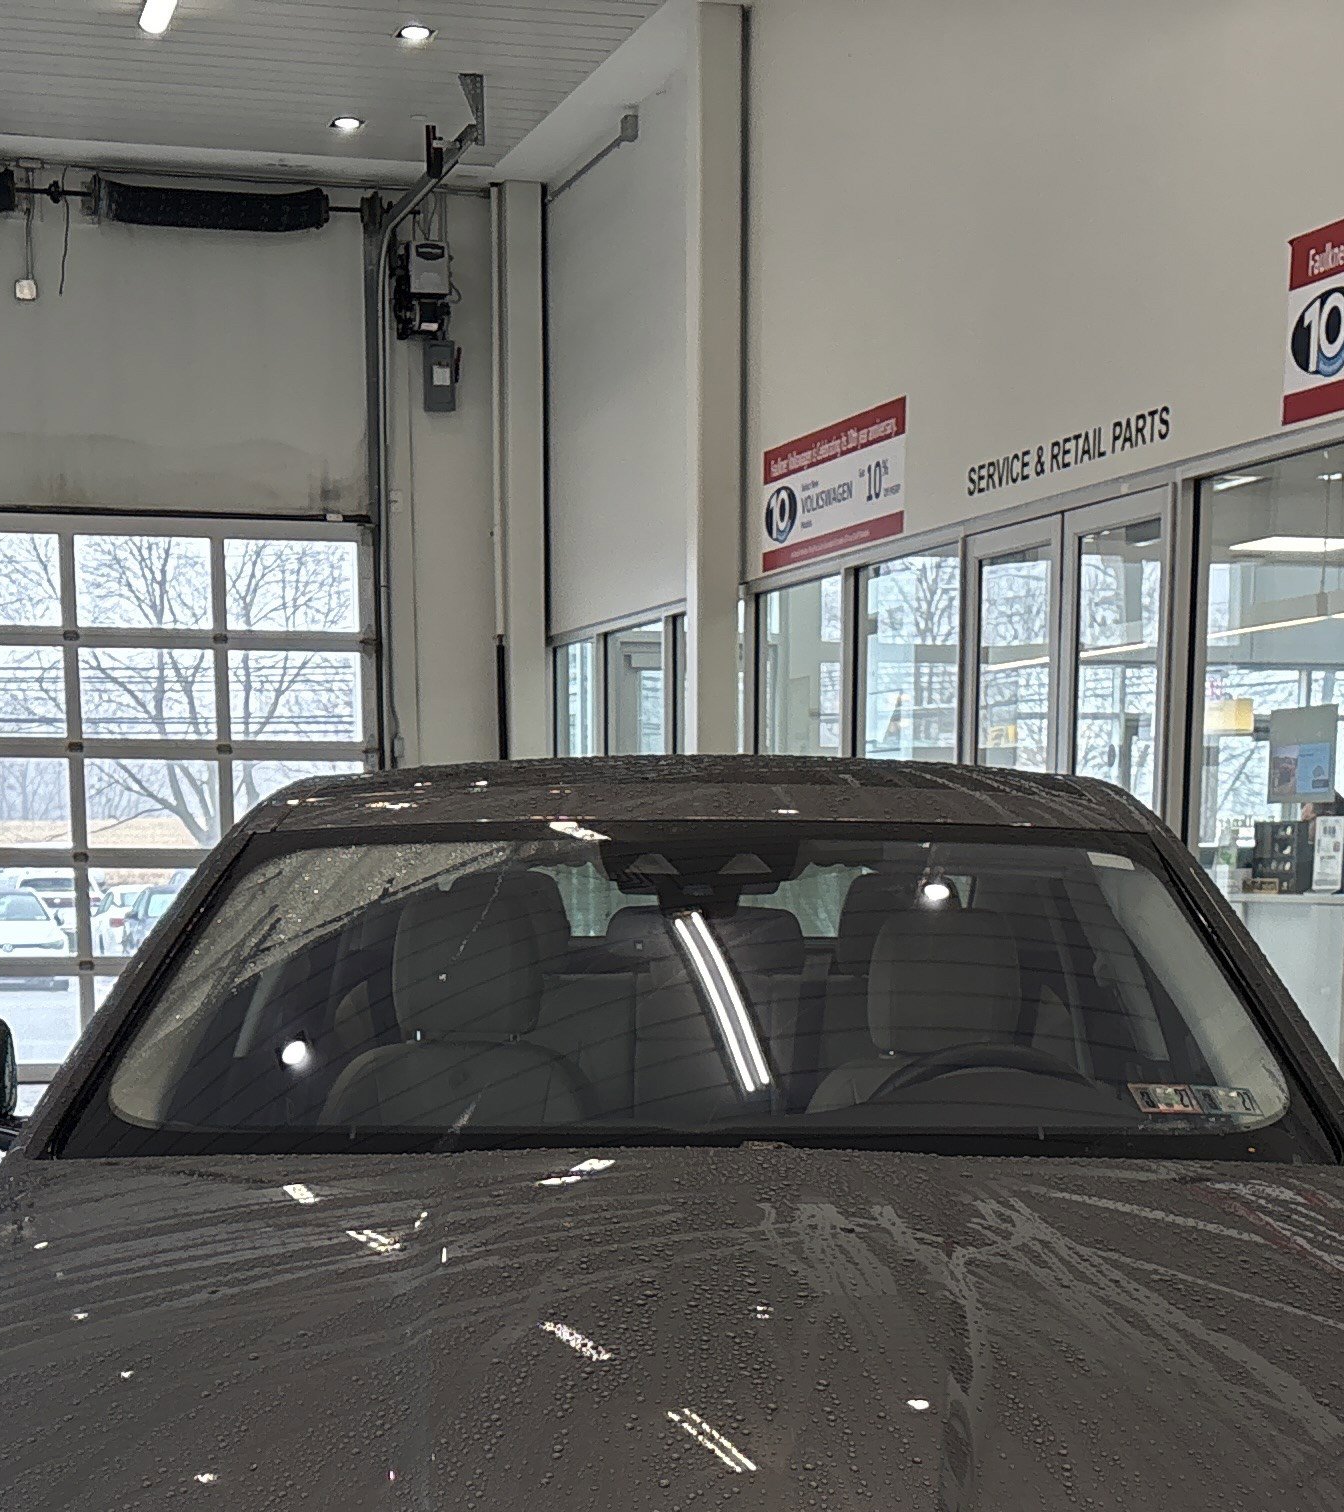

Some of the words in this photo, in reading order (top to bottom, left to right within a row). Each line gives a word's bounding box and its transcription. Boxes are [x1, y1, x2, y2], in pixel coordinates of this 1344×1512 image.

[967, 450, 1031, 497] SERVICE
[1034, 445, 1046, 477] &
[1050, 426, 1107, 473] RETAIL
[1111, 406, 1170, 454] PARTS
